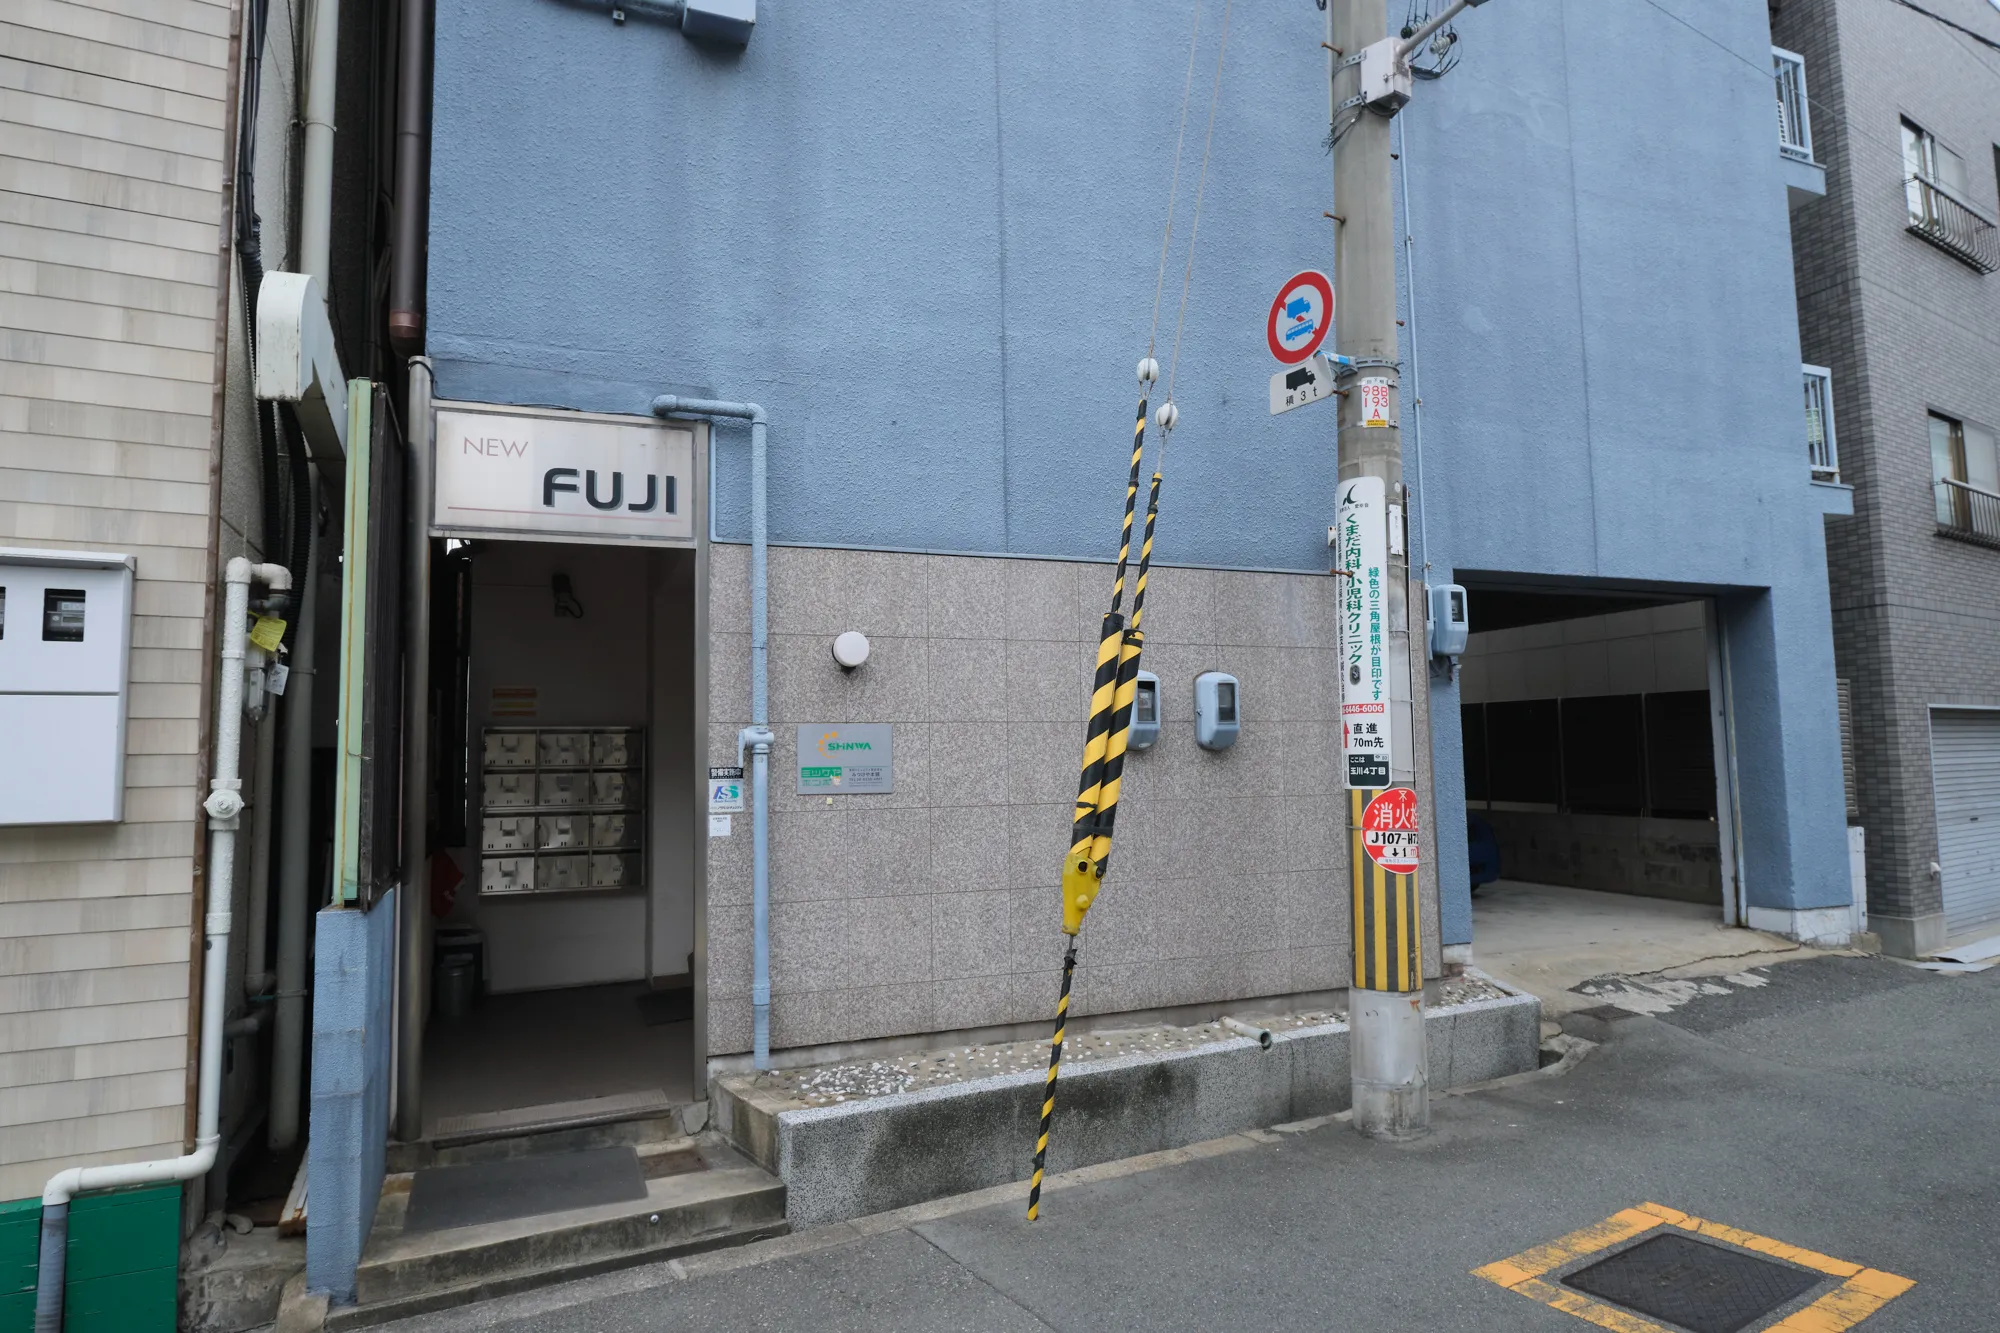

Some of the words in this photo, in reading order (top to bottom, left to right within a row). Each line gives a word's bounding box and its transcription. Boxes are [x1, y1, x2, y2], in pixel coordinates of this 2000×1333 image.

[1285, 395, 1294, 407] 積
[1301, 390, 1307, 402] 3
[1313, 386, 1318, 398] t
[1372, 407, 1381, 420] A
[463, 437, 529, 458] NEW
[543, 467, 678, 515] FUJI
[1368, 566, 1382, 701] 緑色の三角屋根が目印です
[1353, 723, 1378, 734] 直進
[1353, 737, 1384, 748] 70m先
[1350, 766, 1386, 775] 玉川4丁目
[1402, 847, 1407, 857] 1
[1410, 848, 1417, 856] m
